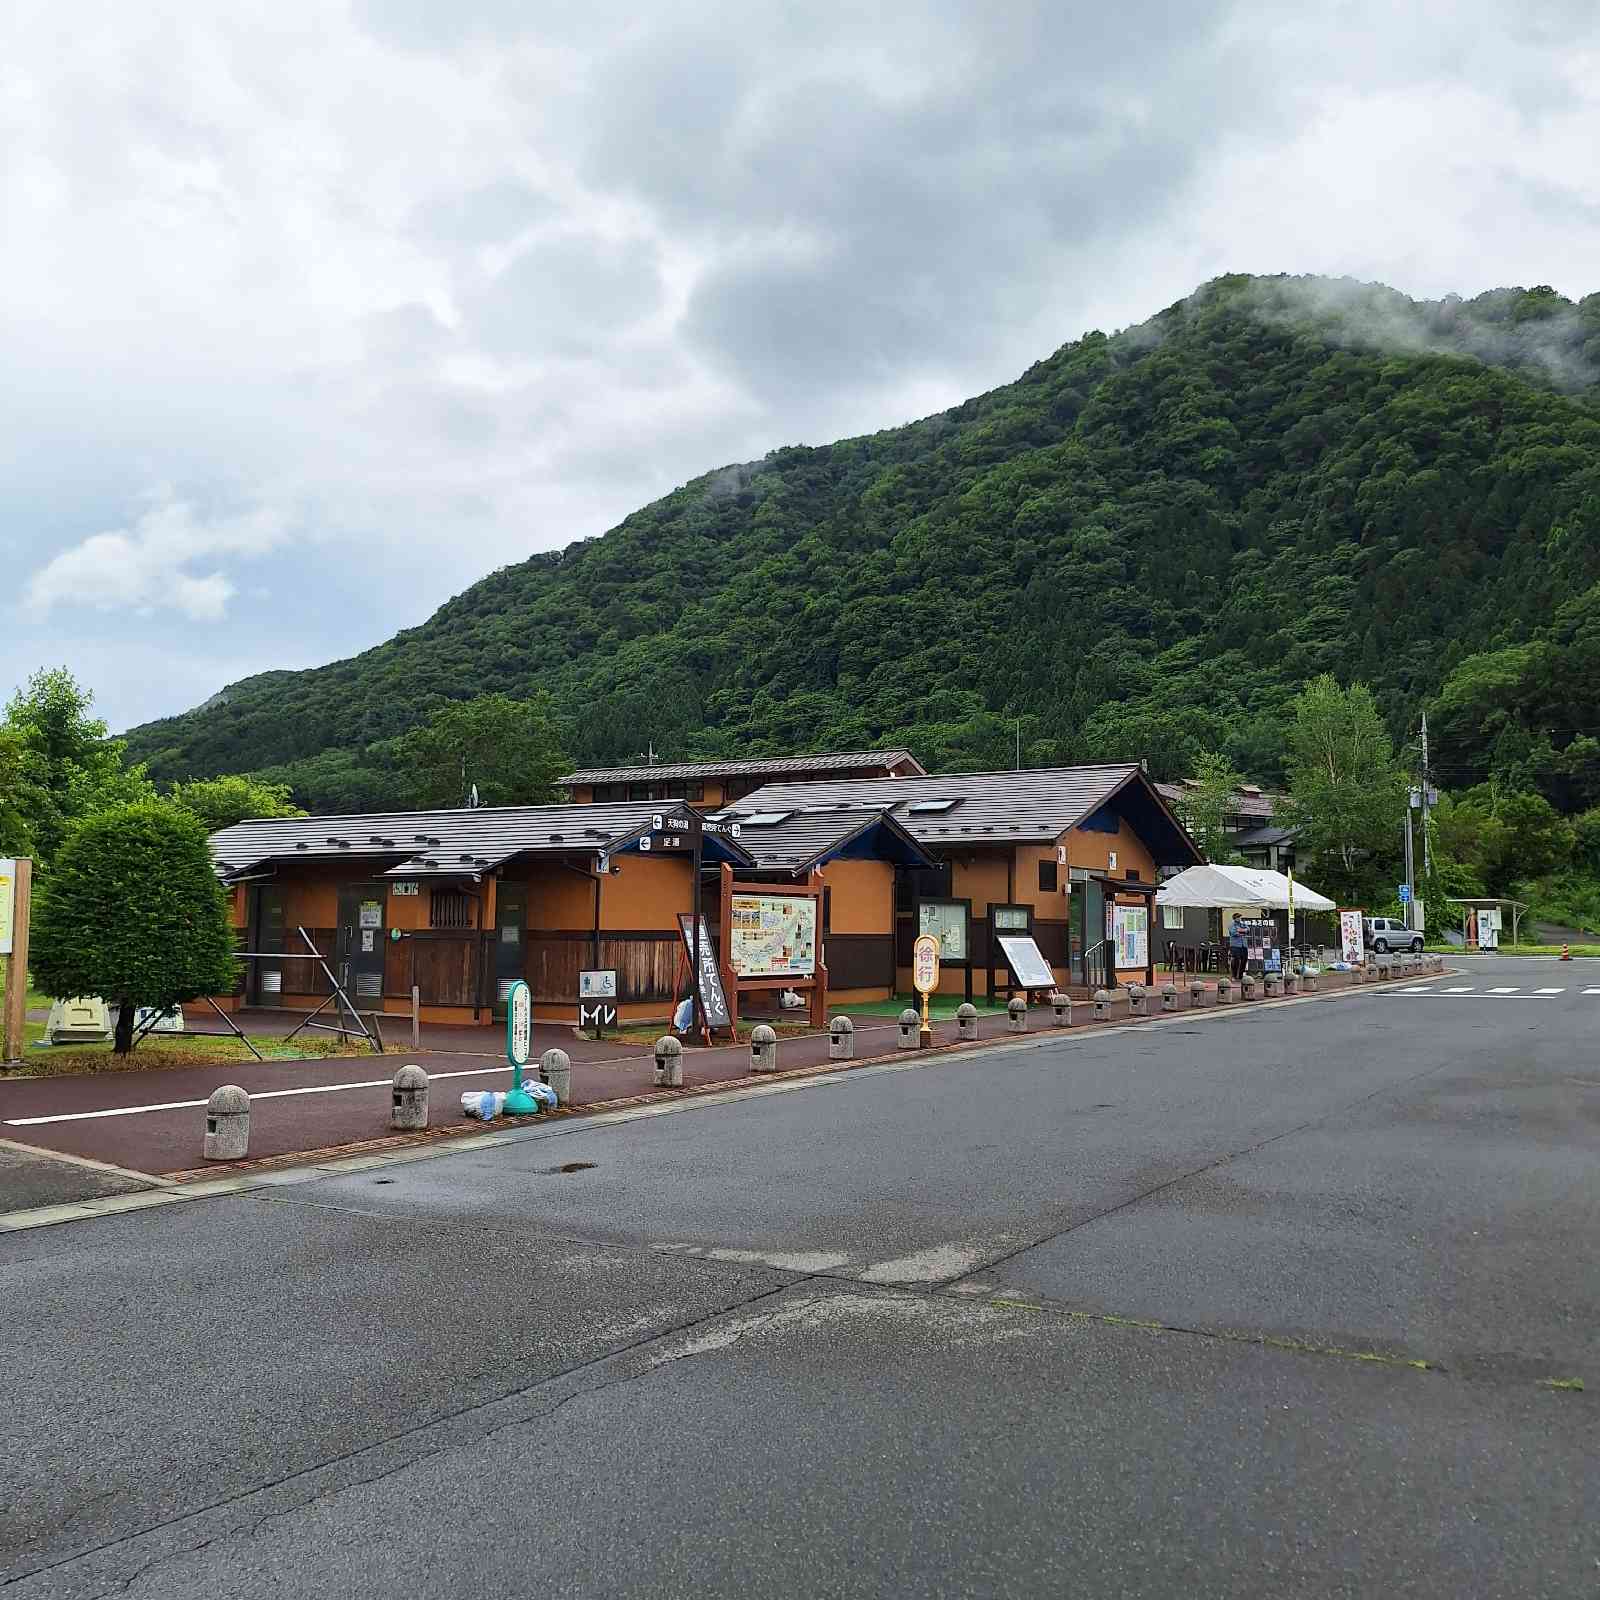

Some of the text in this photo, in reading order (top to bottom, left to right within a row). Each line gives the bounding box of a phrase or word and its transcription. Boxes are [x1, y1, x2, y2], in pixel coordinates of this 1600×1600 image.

[918, 945, 934, 983] 徐行
[580, 1004, 616, 1026] トイレ
